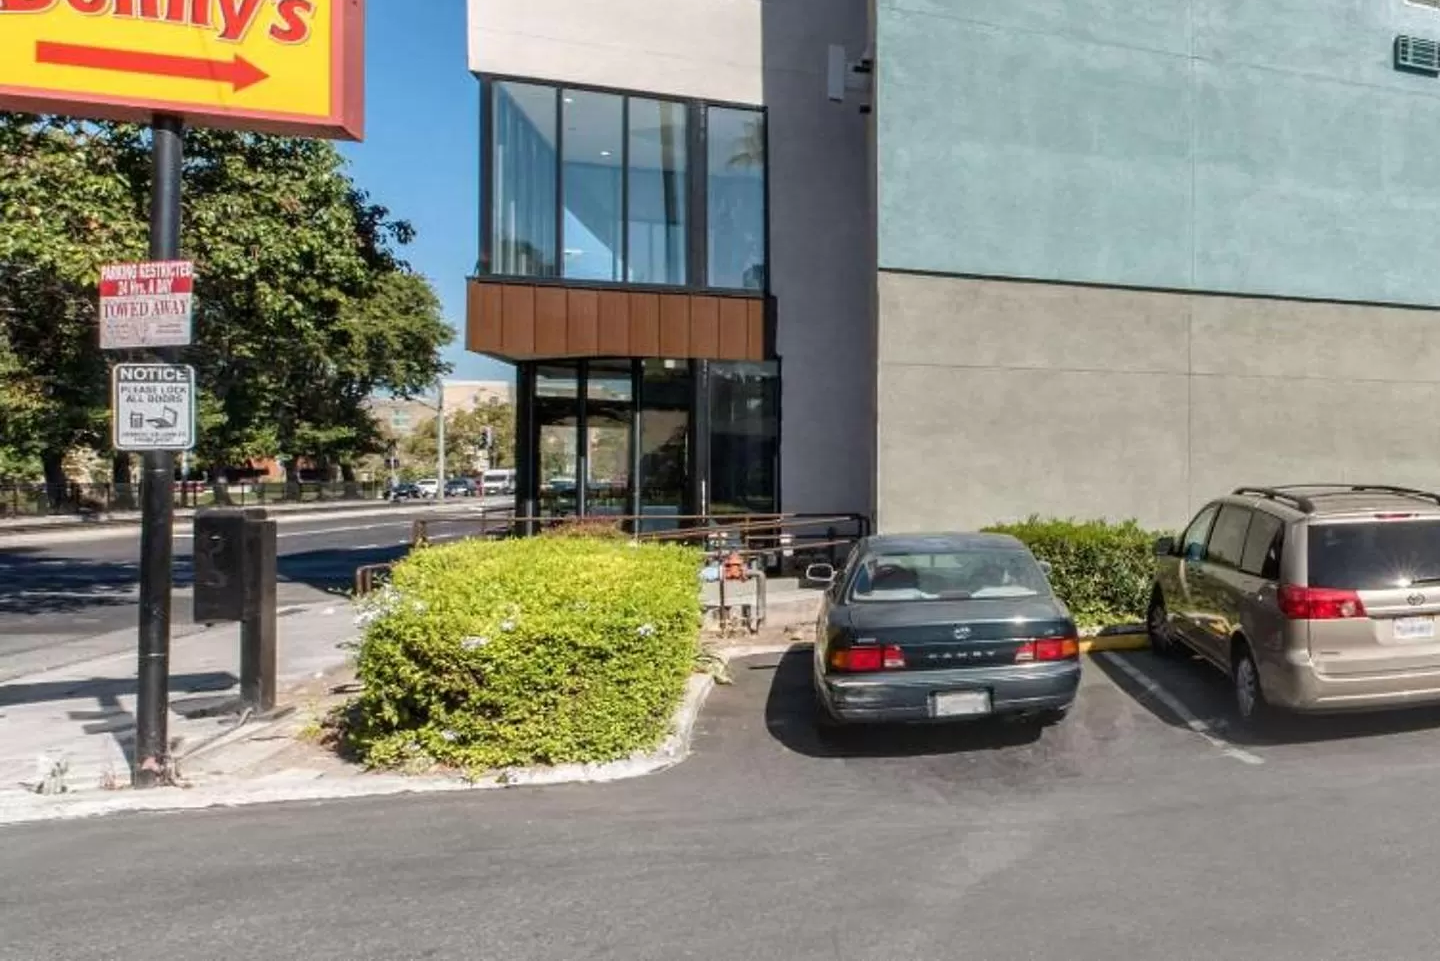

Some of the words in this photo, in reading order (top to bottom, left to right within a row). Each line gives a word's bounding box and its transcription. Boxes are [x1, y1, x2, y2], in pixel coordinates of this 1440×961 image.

[101, 264, 136, 280] PARKING
[139, 261, 192, 278] RESTRICTED
[103, 301, 149, 319] TOWED
[151, 298, 188, 316] AWAY
[120, 367, 188, 380] NOTICE
[160, 385, 187, 393] LOCK
[126, 394, 144, 403] ALL
[147, 394, 183, 403] DOORS
